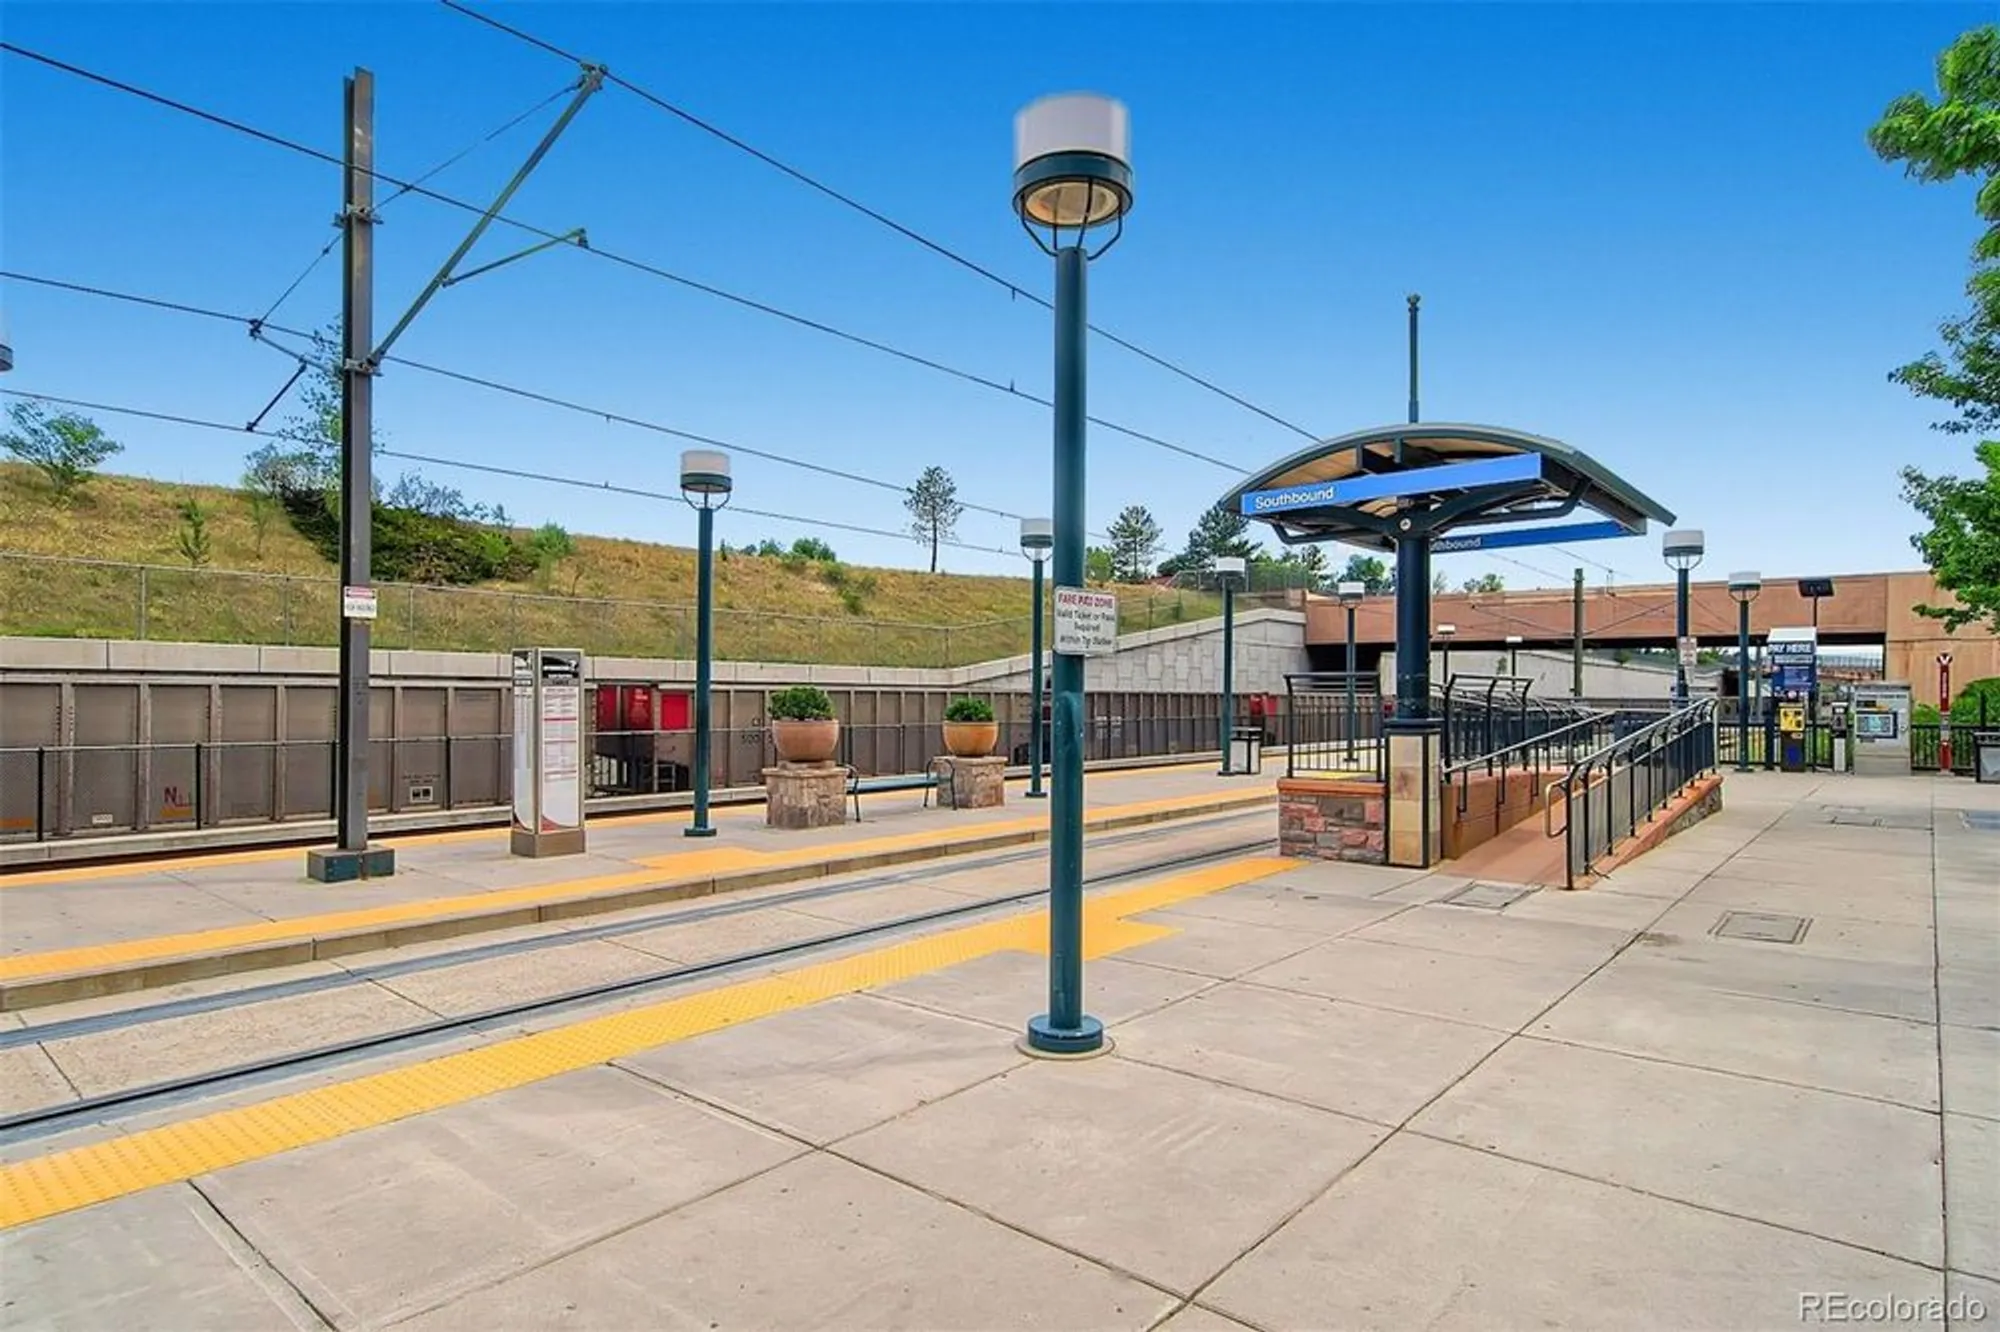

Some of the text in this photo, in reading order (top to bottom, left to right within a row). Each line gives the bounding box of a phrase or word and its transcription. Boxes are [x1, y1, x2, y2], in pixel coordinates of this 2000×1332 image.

[1255, 486, 1334, 510] Southbound
[1430, 535, 1482, 549] uthbound
[1058, 592, 1077, 605] FARE
